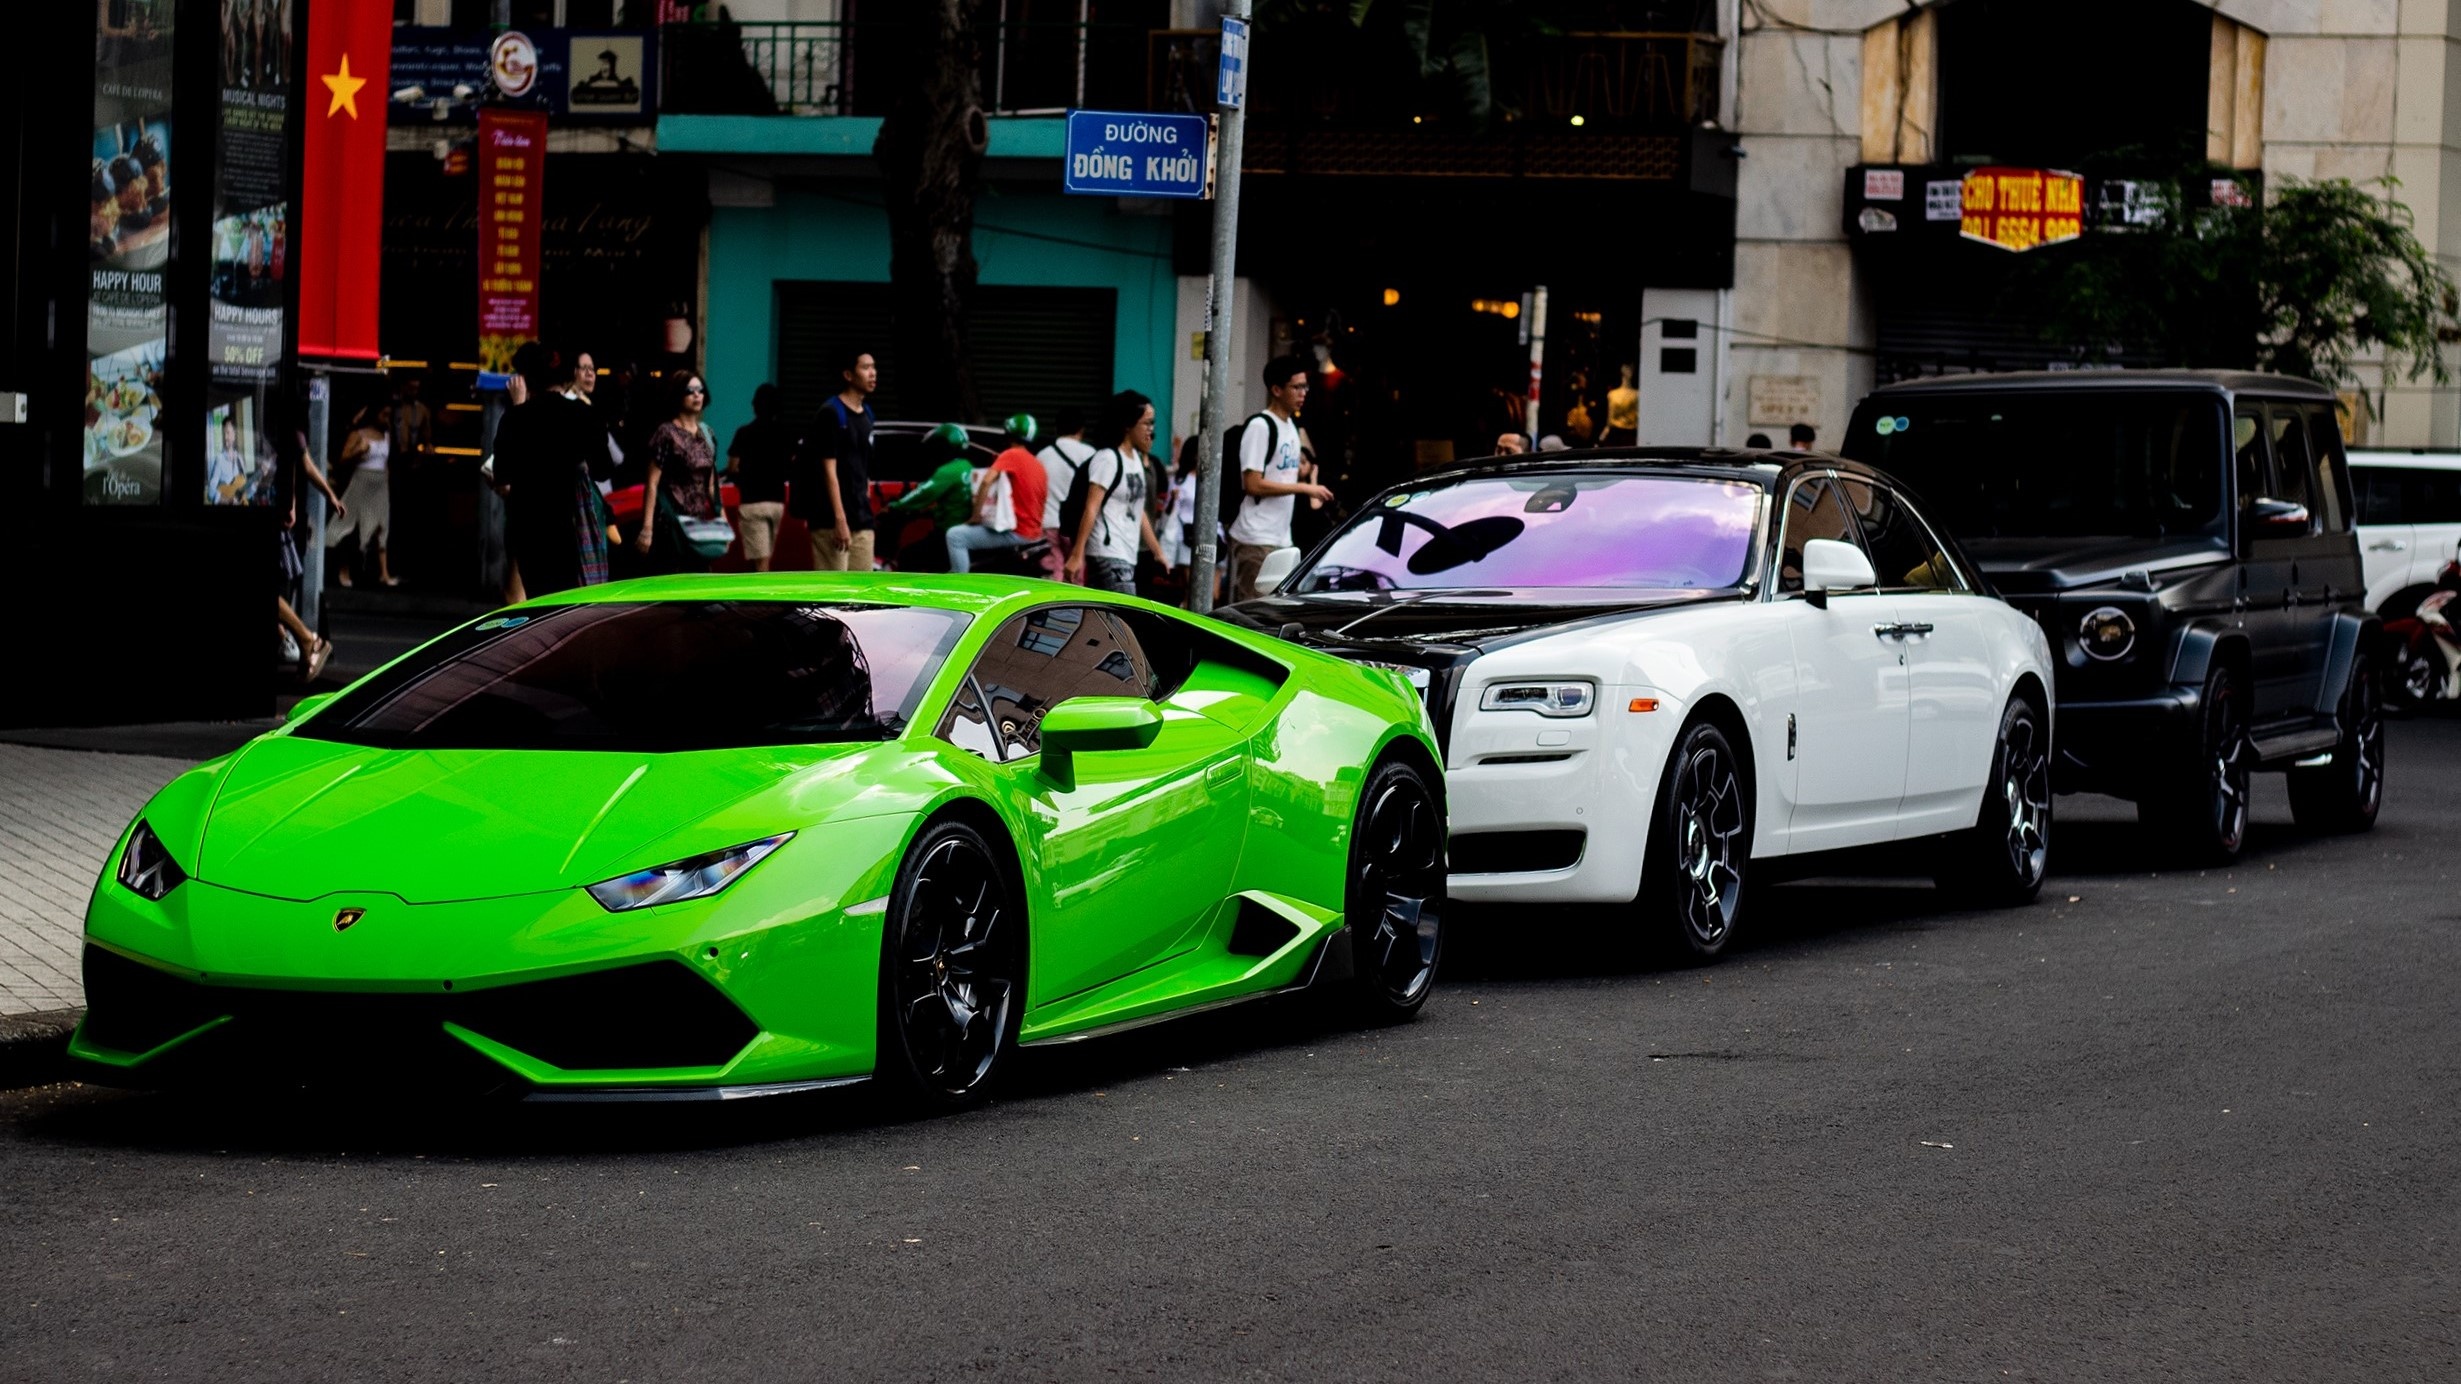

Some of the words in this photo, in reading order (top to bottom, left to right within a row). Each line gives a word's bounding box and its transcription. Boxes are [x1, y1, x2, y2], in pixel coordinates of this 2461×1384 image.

[222, 88, 256, 106] MUSICAL
[257, 93, 287, 110] NIGHTS
[1105, 121, 1177, 144] ĐƯỜNG
[1073, 145, 1132, 181] ĐỒNG
[1146, 148, 1198, 183] KHỞI
[1963, 175, 1994, 211] CHO
[93, 270, 129, 291] HAPPY
[131, 272, 162, 293] HOUR
[215, 304, 243, 323] HAPPY
[245, 307, 278, 326] HOURS
[224, 346, 244, 365] 50%
[246, 347, 264, 365] OFF
